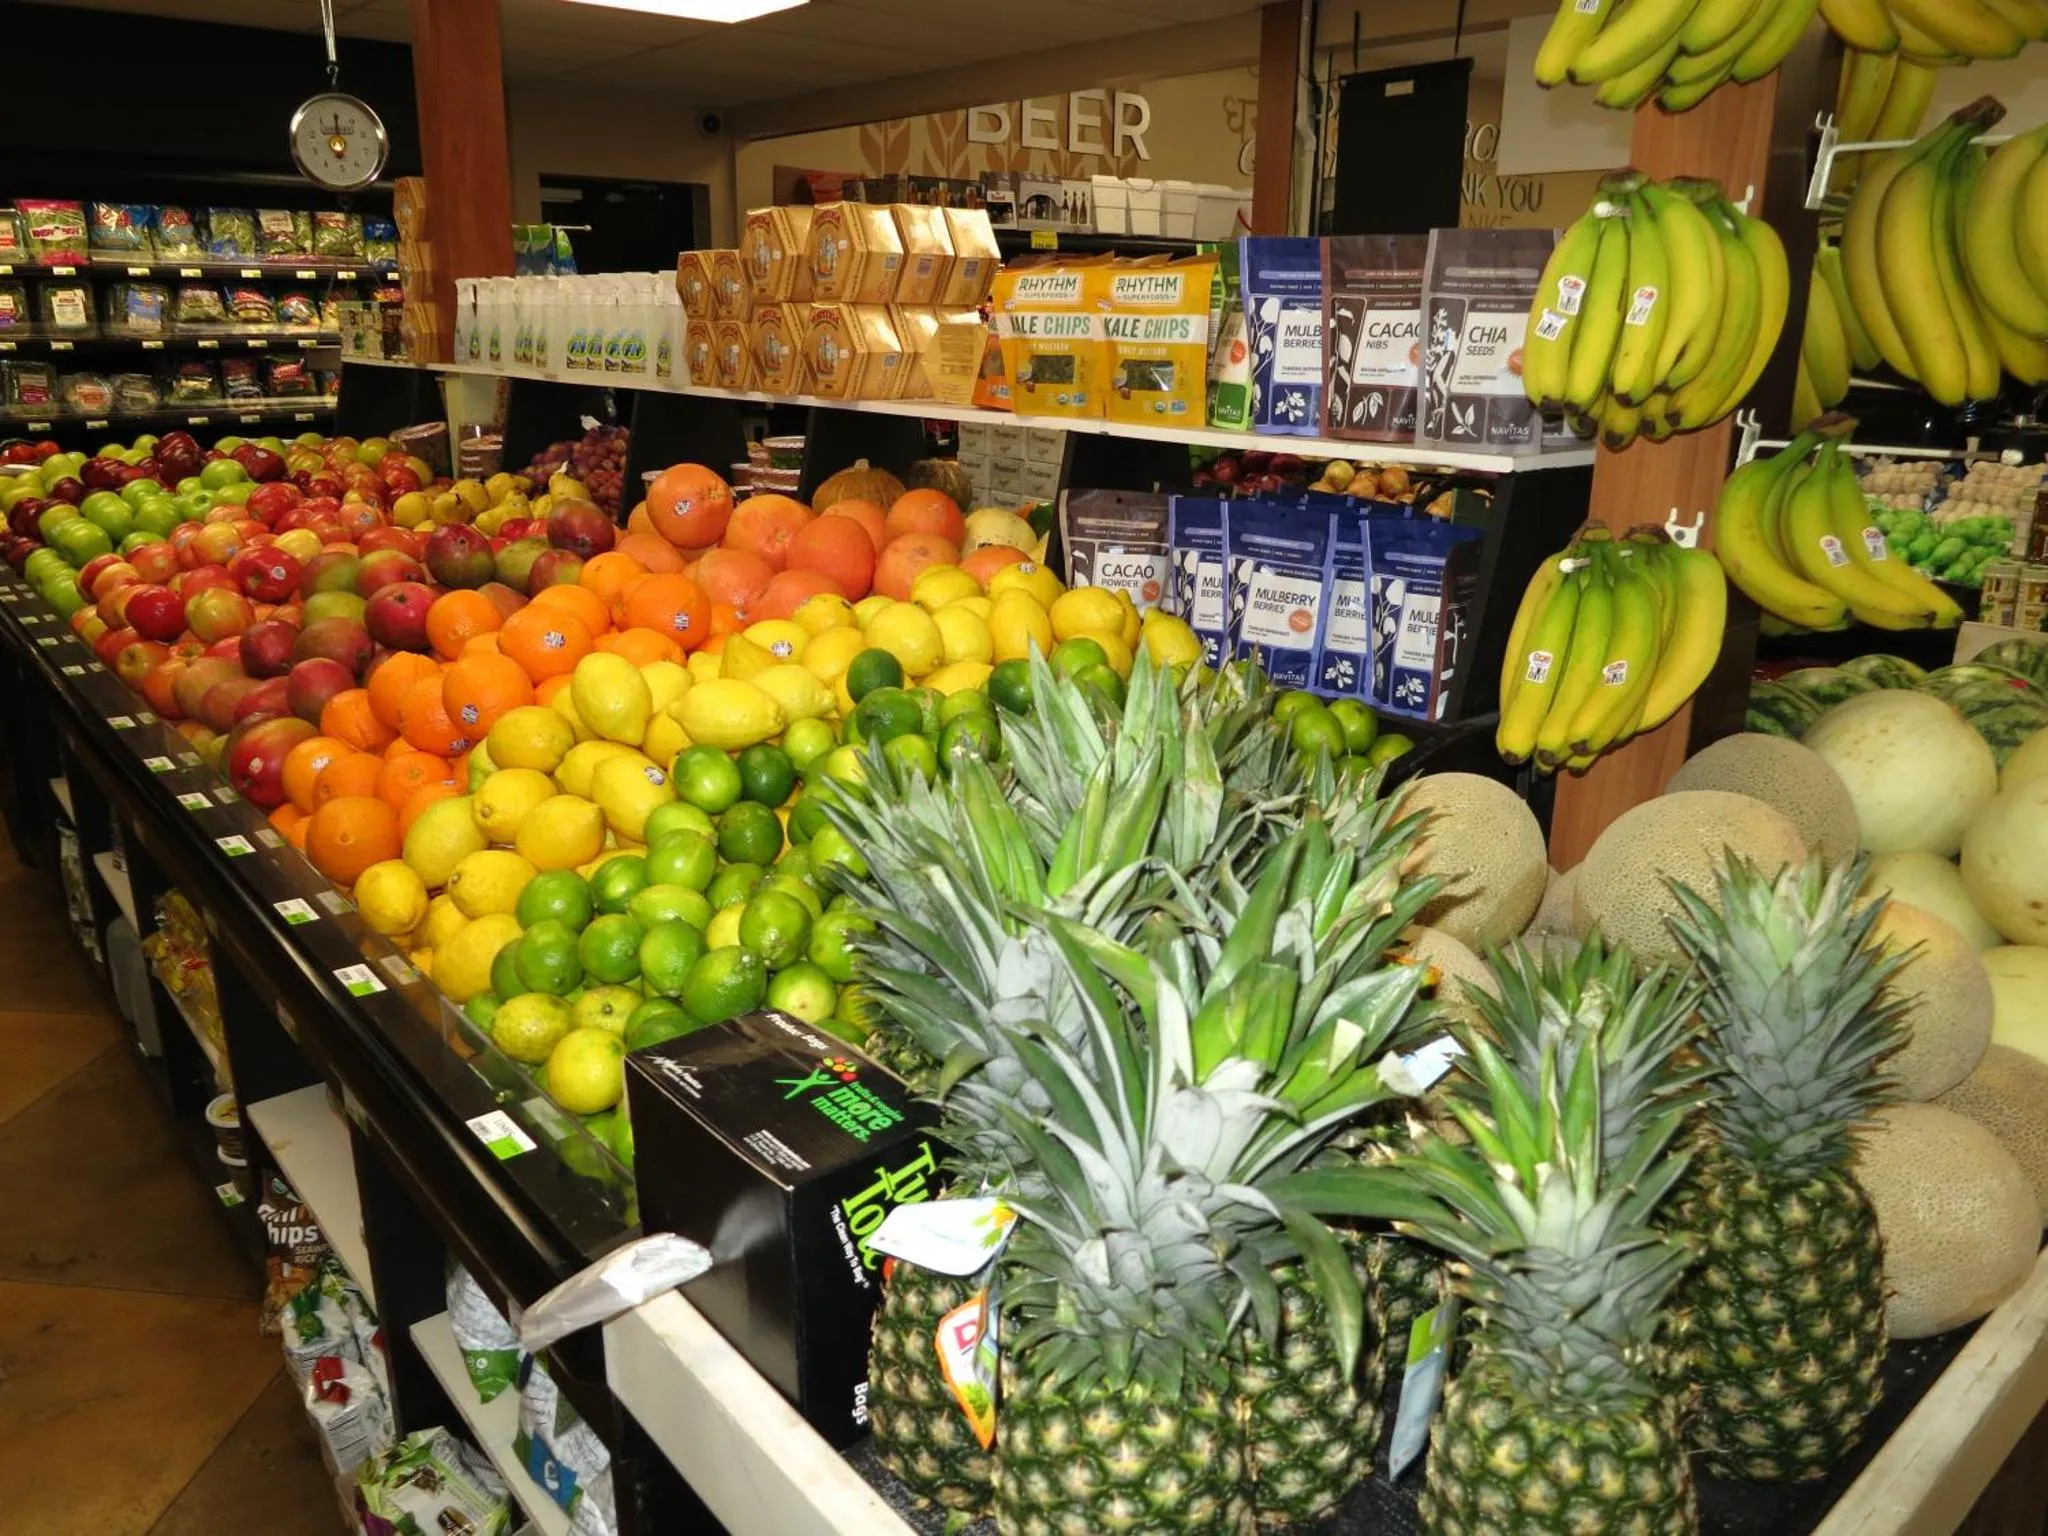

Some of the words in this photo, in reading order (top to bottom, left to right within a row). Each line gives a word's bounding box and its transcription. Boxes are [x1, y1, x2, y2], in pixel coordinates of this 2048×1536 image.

[967, 88, 1151, 161] BEER
[1496, 177, 1543, 213] YOU
[1018, 276, 1078, 292] RHYTHM
[1116, 277, 1178, 293] RHYTHM
[1043, 316, 1092, 335] CHIPS
[1104, 317, 1141, 338] KALE
[1143, 318, 1190, 339] CHIPS
[1468, 326, 1507, 344] CHIA
[1366, 340, 1388, 350] NIBS
[1465, 345, 1495, 356] SEEDS
[1490, 425, 1530, 436] NAVITAS
[1101, 563, 1155, 579] CACAO
[1101, 578, 1139, 588] POWDER
[1254, 587, 1317, 608] MULBERRY
[1252, 600, 1286, 614] BERRIES
[1272, 669, 1305, 682] NAVITAS
[828, 1086, 893, 1131] more
[853, 1381, 870, 1425] Bags
